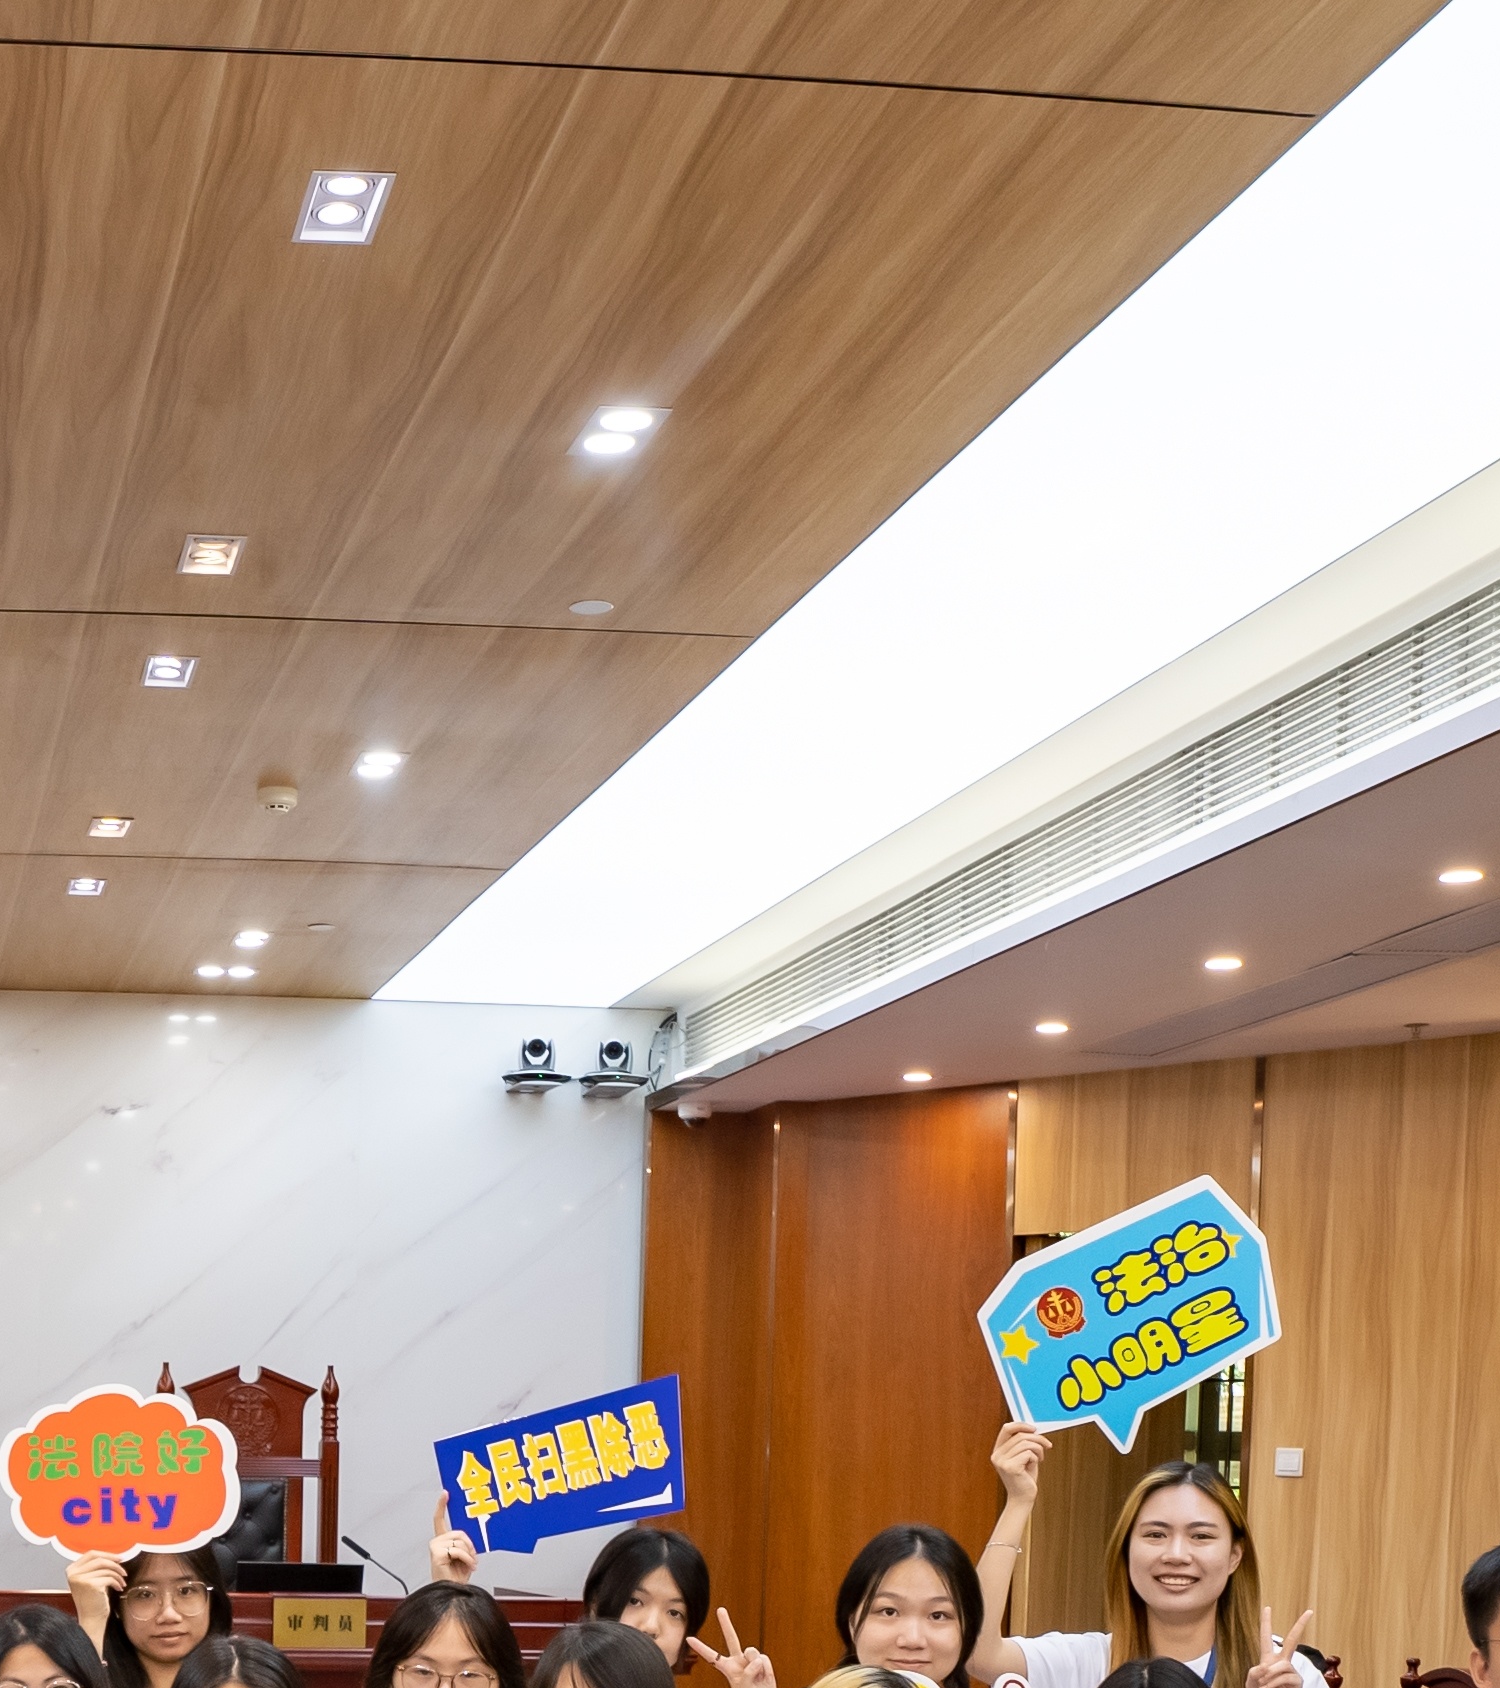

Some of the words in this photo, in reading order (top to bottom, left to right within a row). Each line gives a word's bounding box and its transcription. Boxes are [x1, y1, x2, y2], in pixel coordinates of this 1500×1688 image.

[1092, 1220, 1231, 1316] 法治
[1057, 1286, 1249, 1412] 小明星
[27, 1429, 210, 1481] 法院好
[456, 1400, 671, 1519] 全民扫黑除恶
[61, 1487, 178, 1530] city
[287, 1614, 352, 1632] 审判员
